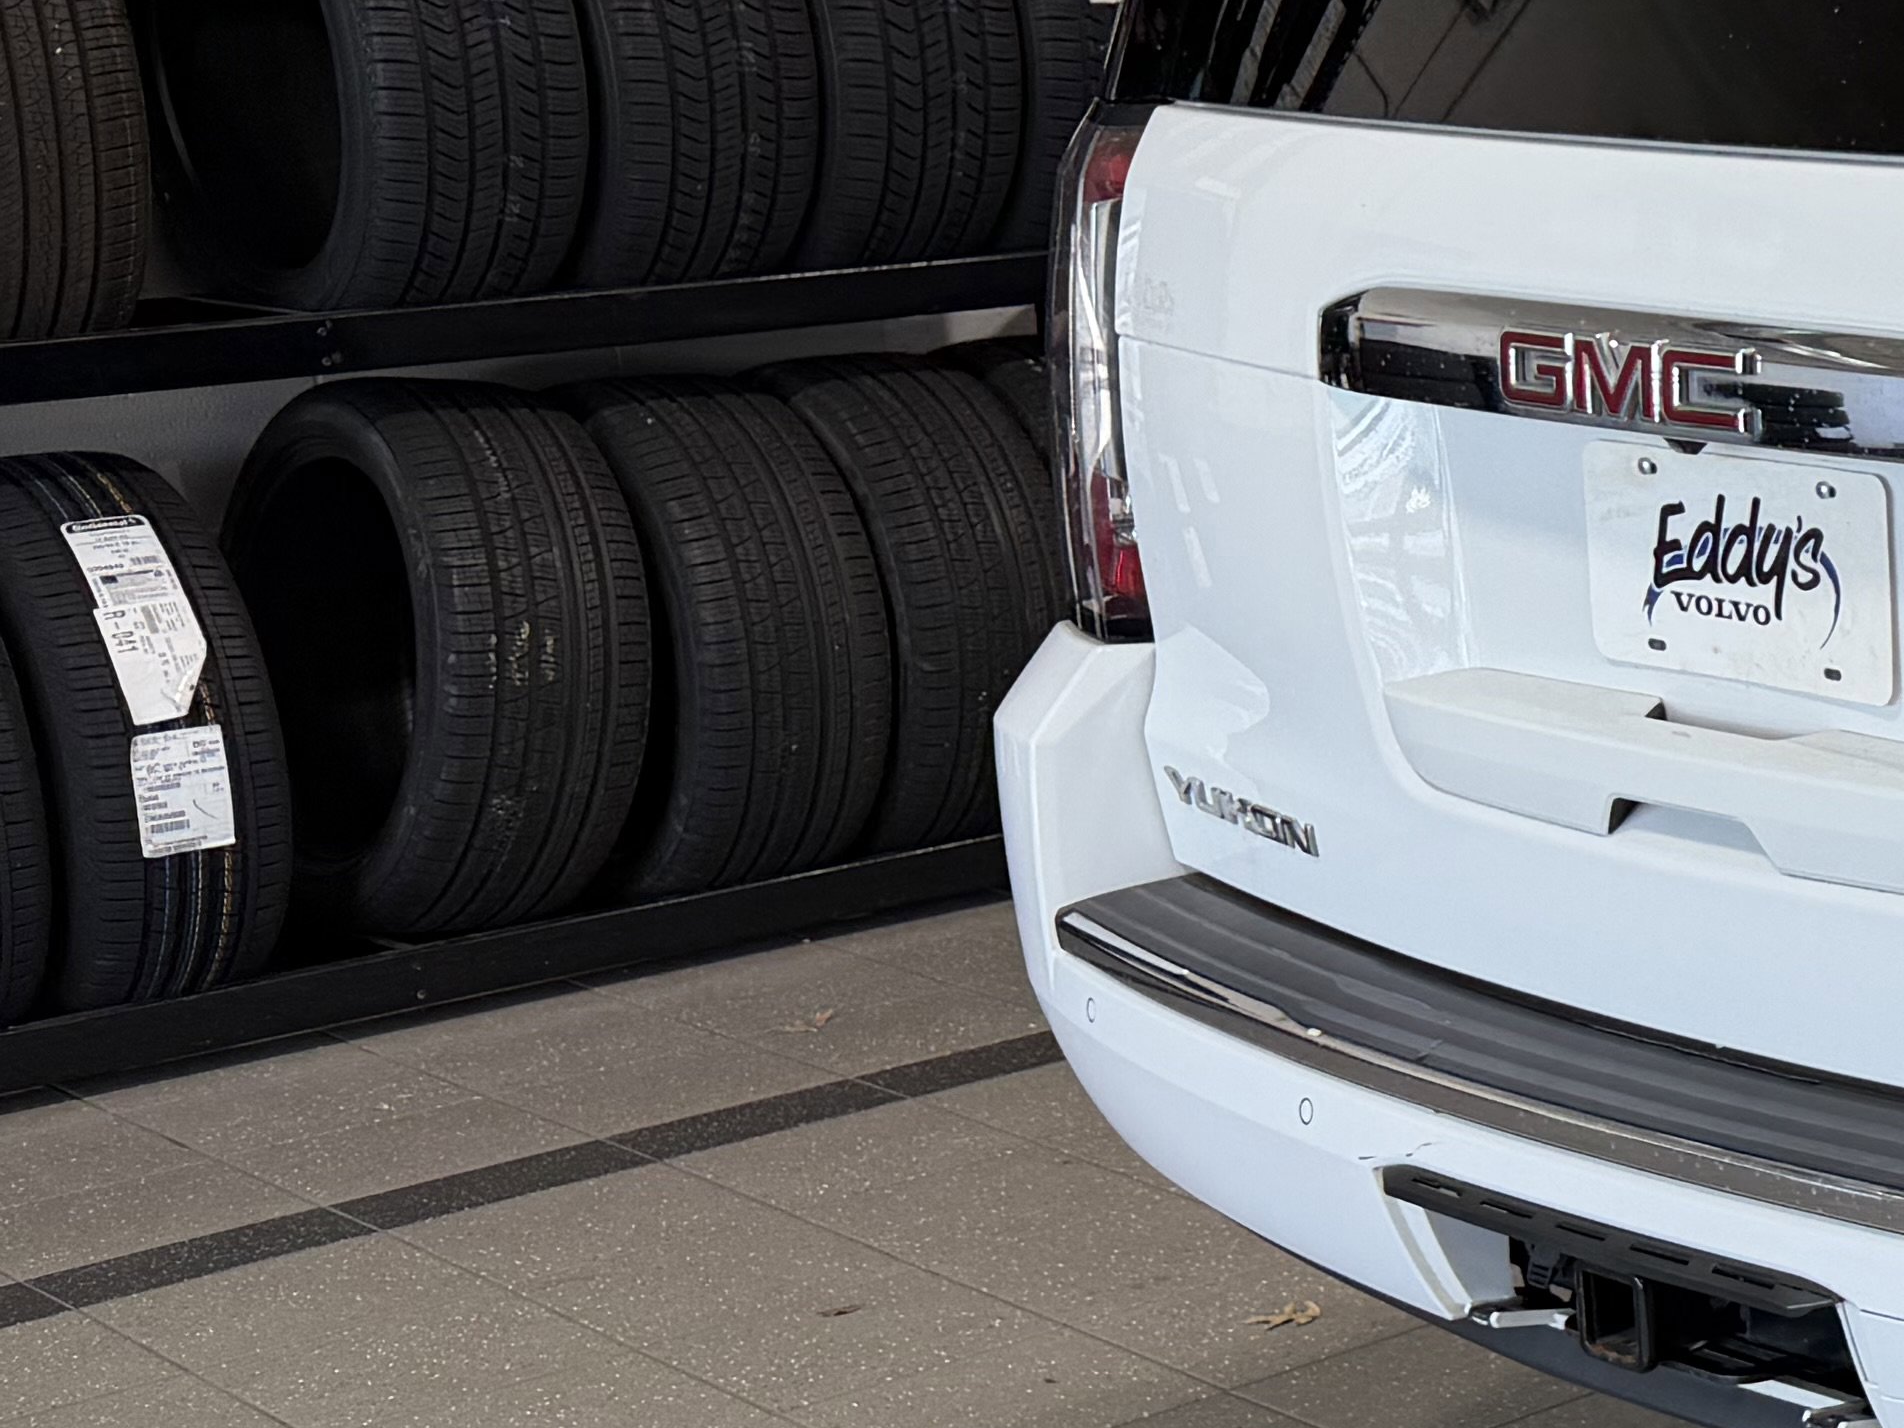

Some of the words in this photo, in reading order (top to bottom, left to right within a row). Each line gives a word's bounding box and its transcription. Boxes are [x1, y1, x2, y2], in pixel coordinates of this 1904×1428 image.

[1498, 328, 1763, 442] GMC
[1652, 493, 1824, 622] Eddy's
[1670, 590, 1772, 627] VOLVO
[1162, 764, 1321, 858] YUKON
